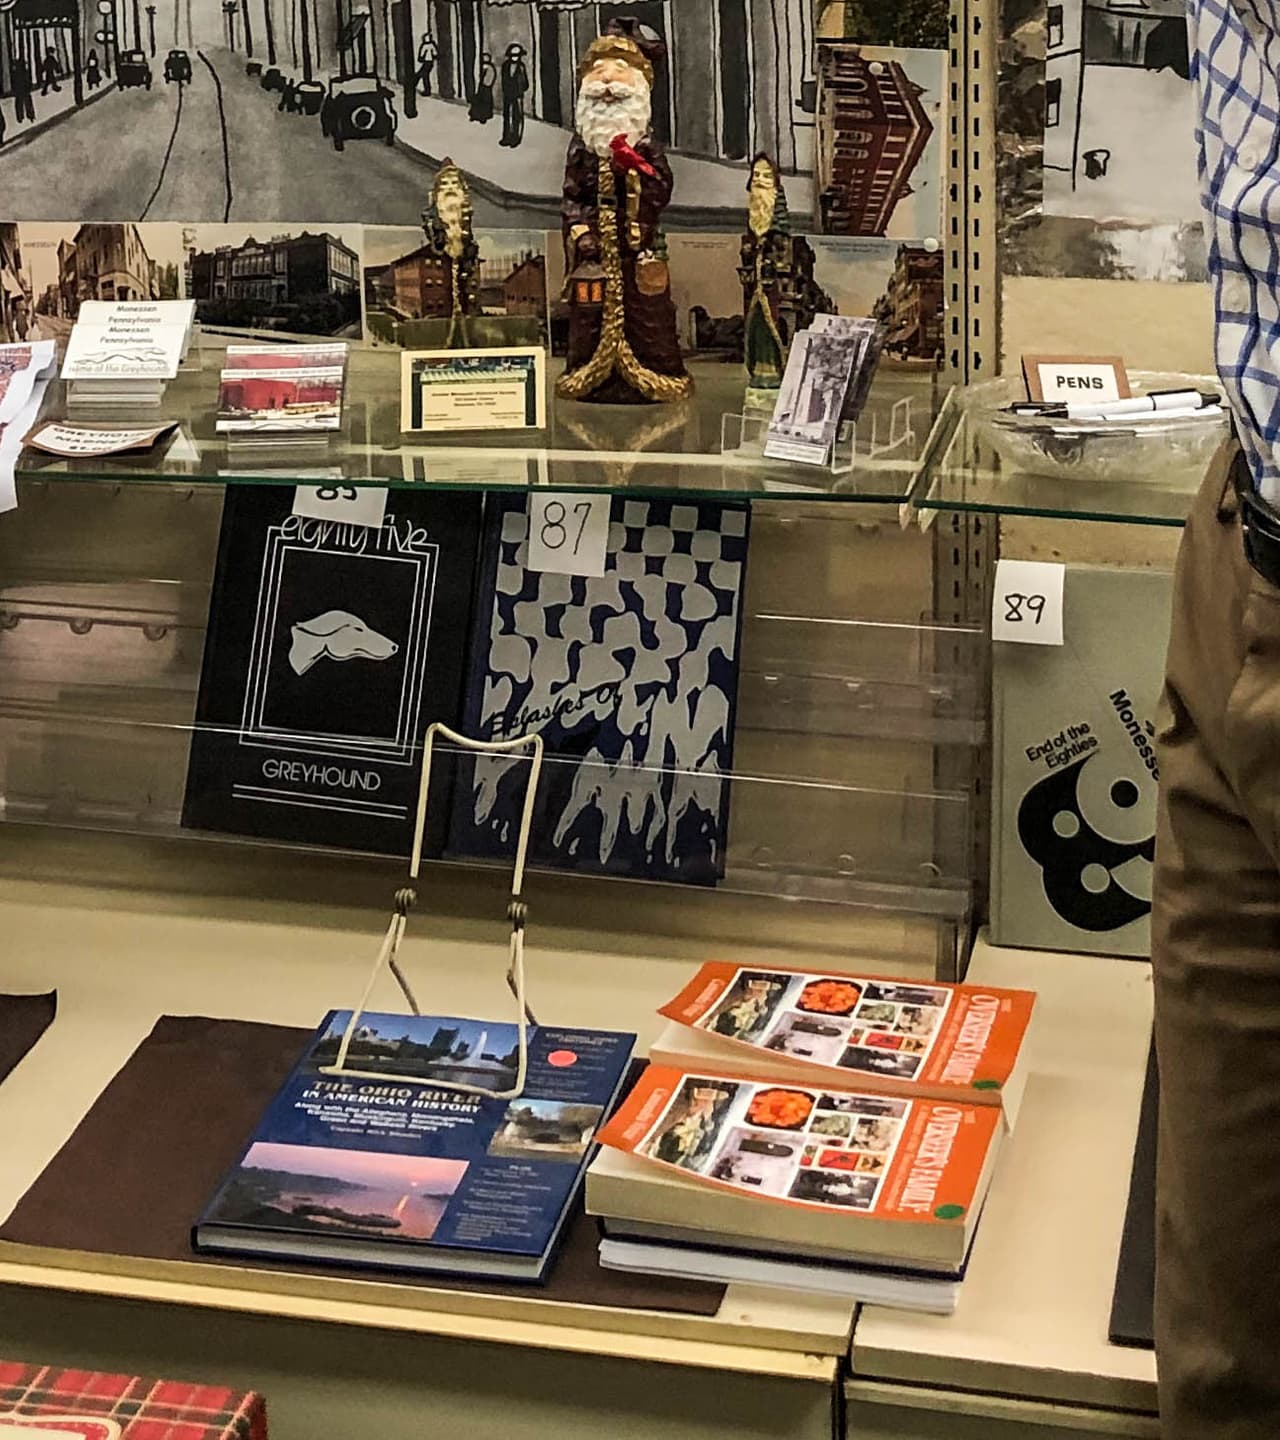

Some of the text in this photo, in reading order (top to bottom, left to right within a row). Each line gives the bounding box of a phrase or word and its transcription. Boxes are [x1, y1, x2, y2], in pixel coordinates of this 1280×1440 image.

[1056, 375, 1104, 390] PENS
[541, 501, 592, 555] 87
[1004, 593, 1046, 624] 89
[1025, 723, 1091, 761] End of the
[1045, 736, 1098, 769] Eighties
[262, 759, 381, 790] GREYHOUND
[302, 1089, 483, 1114] IN AMERICAN HISTORY
[312, 1080, 481, 1105] THE OHIO RIVER
